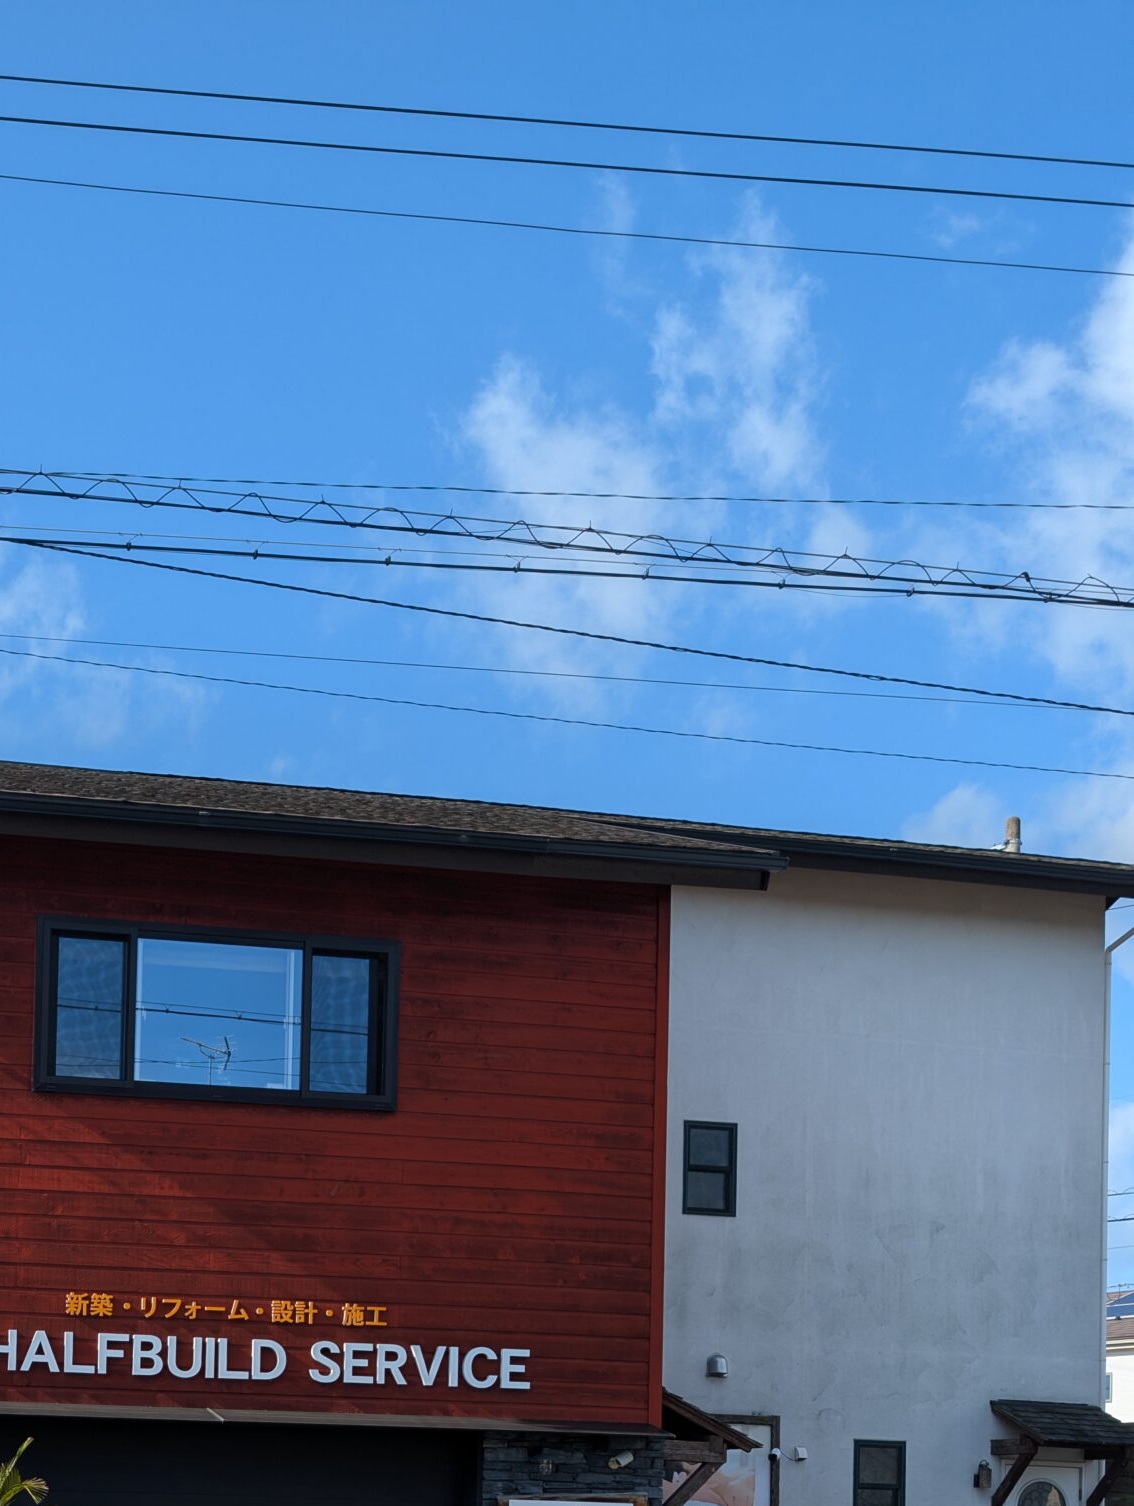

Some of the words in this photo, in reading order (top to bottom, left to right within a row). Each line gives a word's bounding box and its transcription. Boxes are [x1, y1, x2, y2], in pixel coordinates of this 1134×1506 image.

[65, 1291, 388, 1327] 新築・リフォーム・設計・施工
[309, 1339, 532, 1390] SERVICE
